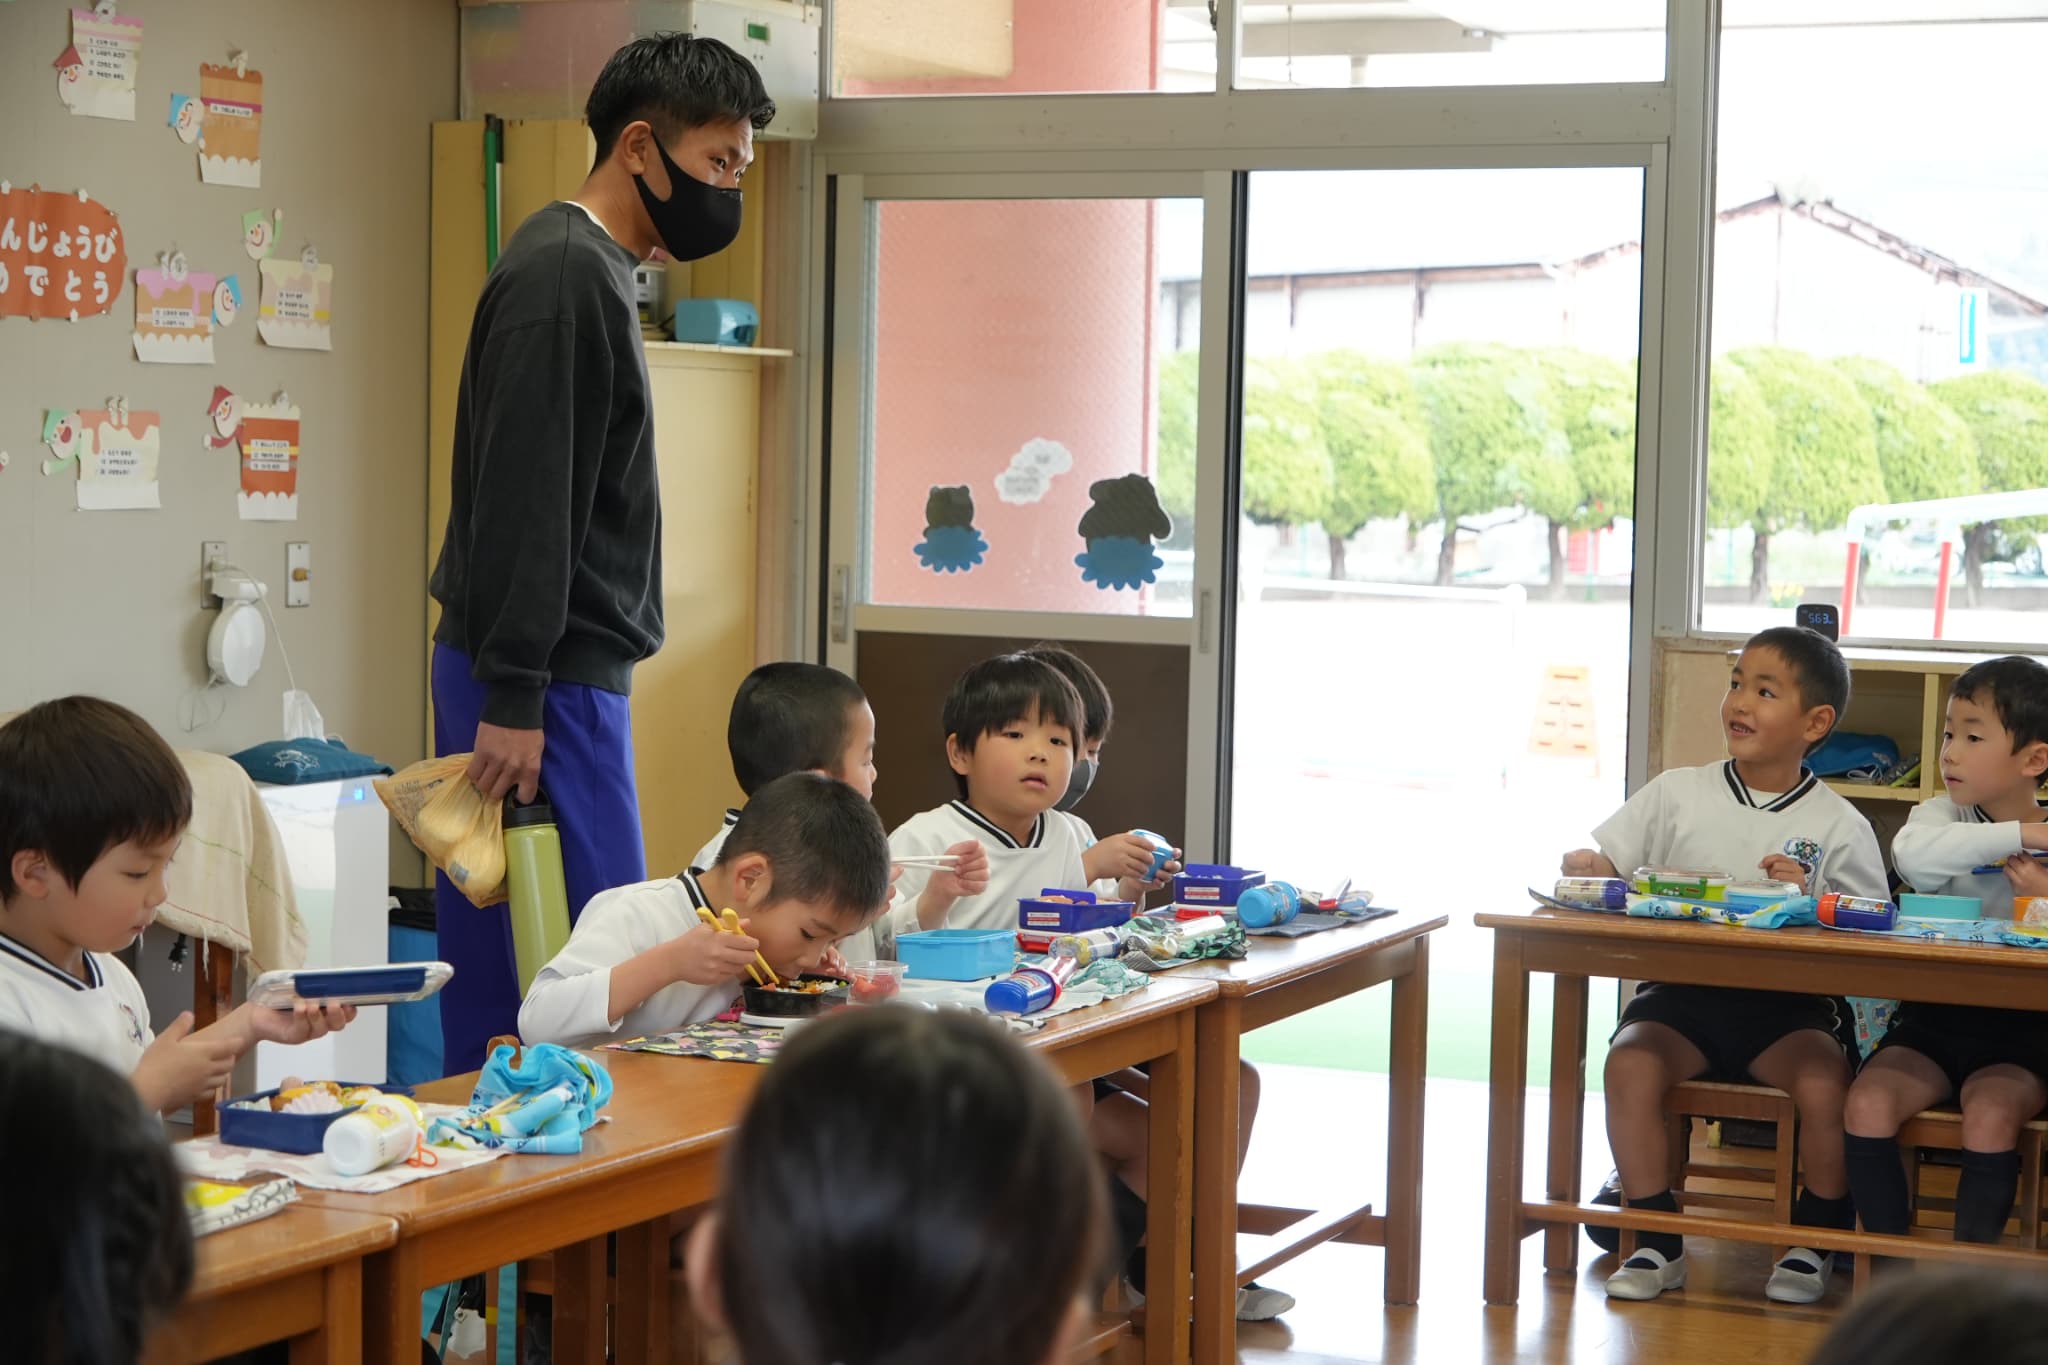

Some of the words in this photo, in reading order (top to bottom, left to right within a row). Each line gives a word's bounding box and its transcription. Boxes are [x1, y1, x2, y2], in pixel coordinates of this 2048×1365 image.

[1, 217, 117, 263] んじょうび
